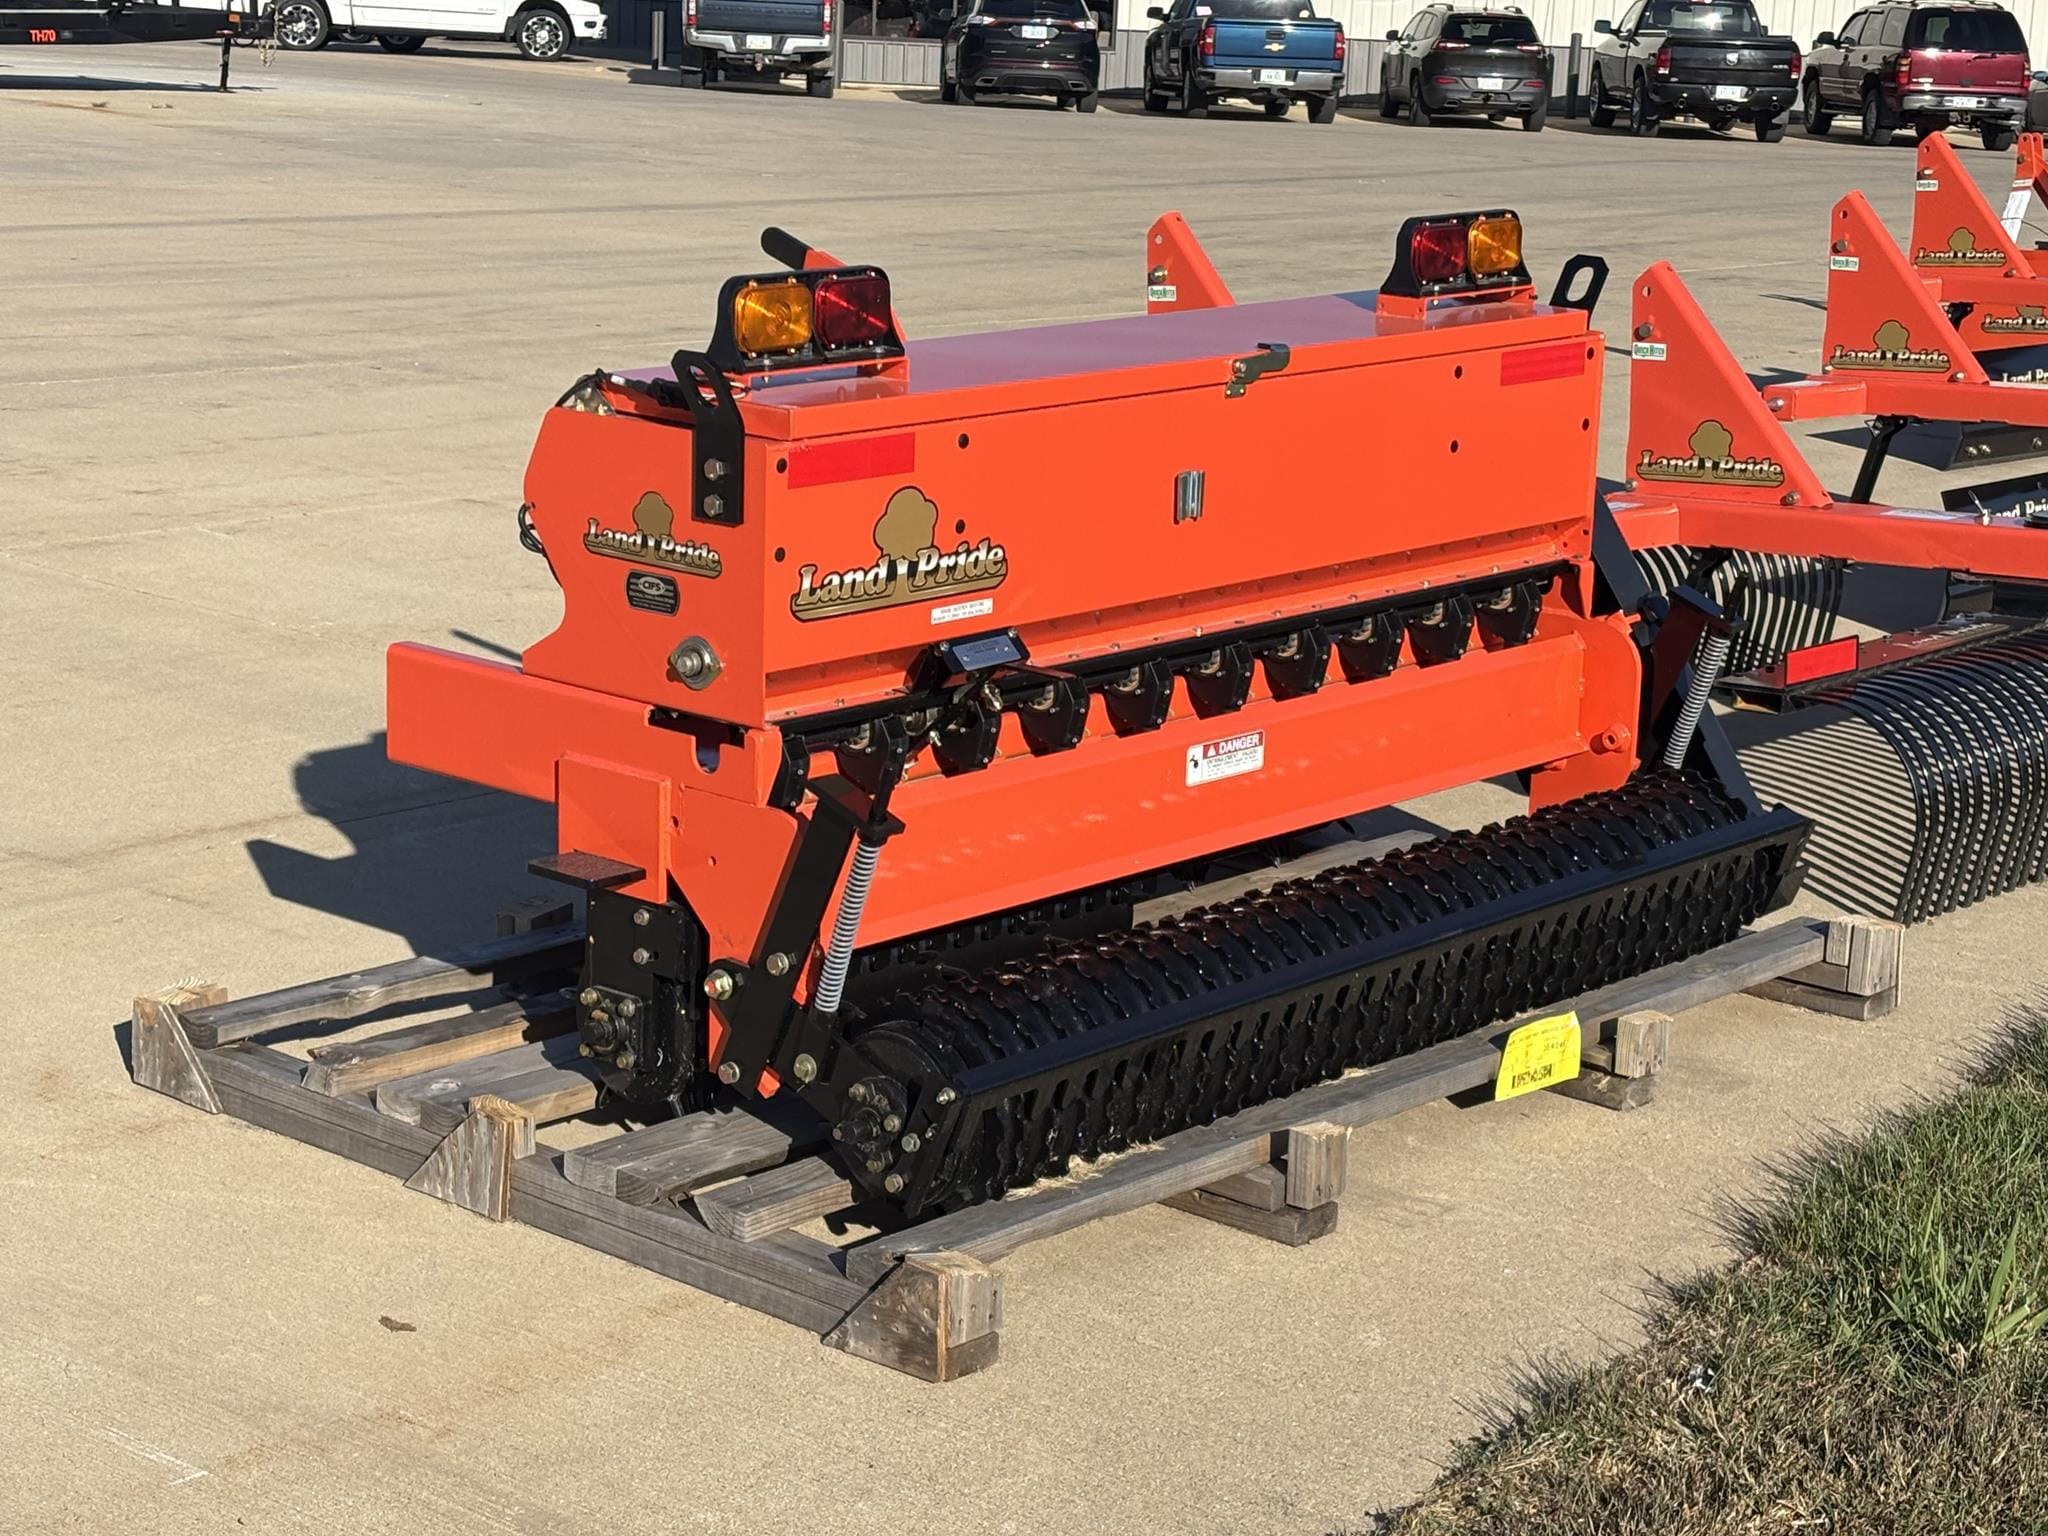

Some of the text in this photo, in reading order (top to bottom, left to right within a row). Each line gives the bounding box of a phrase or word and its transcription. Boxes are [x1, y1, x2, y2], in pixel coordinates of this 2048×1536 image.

[30, 29, 56, 43] TH70
[1833, 345, 1949, 367] Land Pride
[1639, 451, 1782, 480] Land Pride
[587, 518, 720, 570] Land Pride
[796, 538, 1005, 606] Land Pride
[1219, 734, 1260, 754] DANGER
